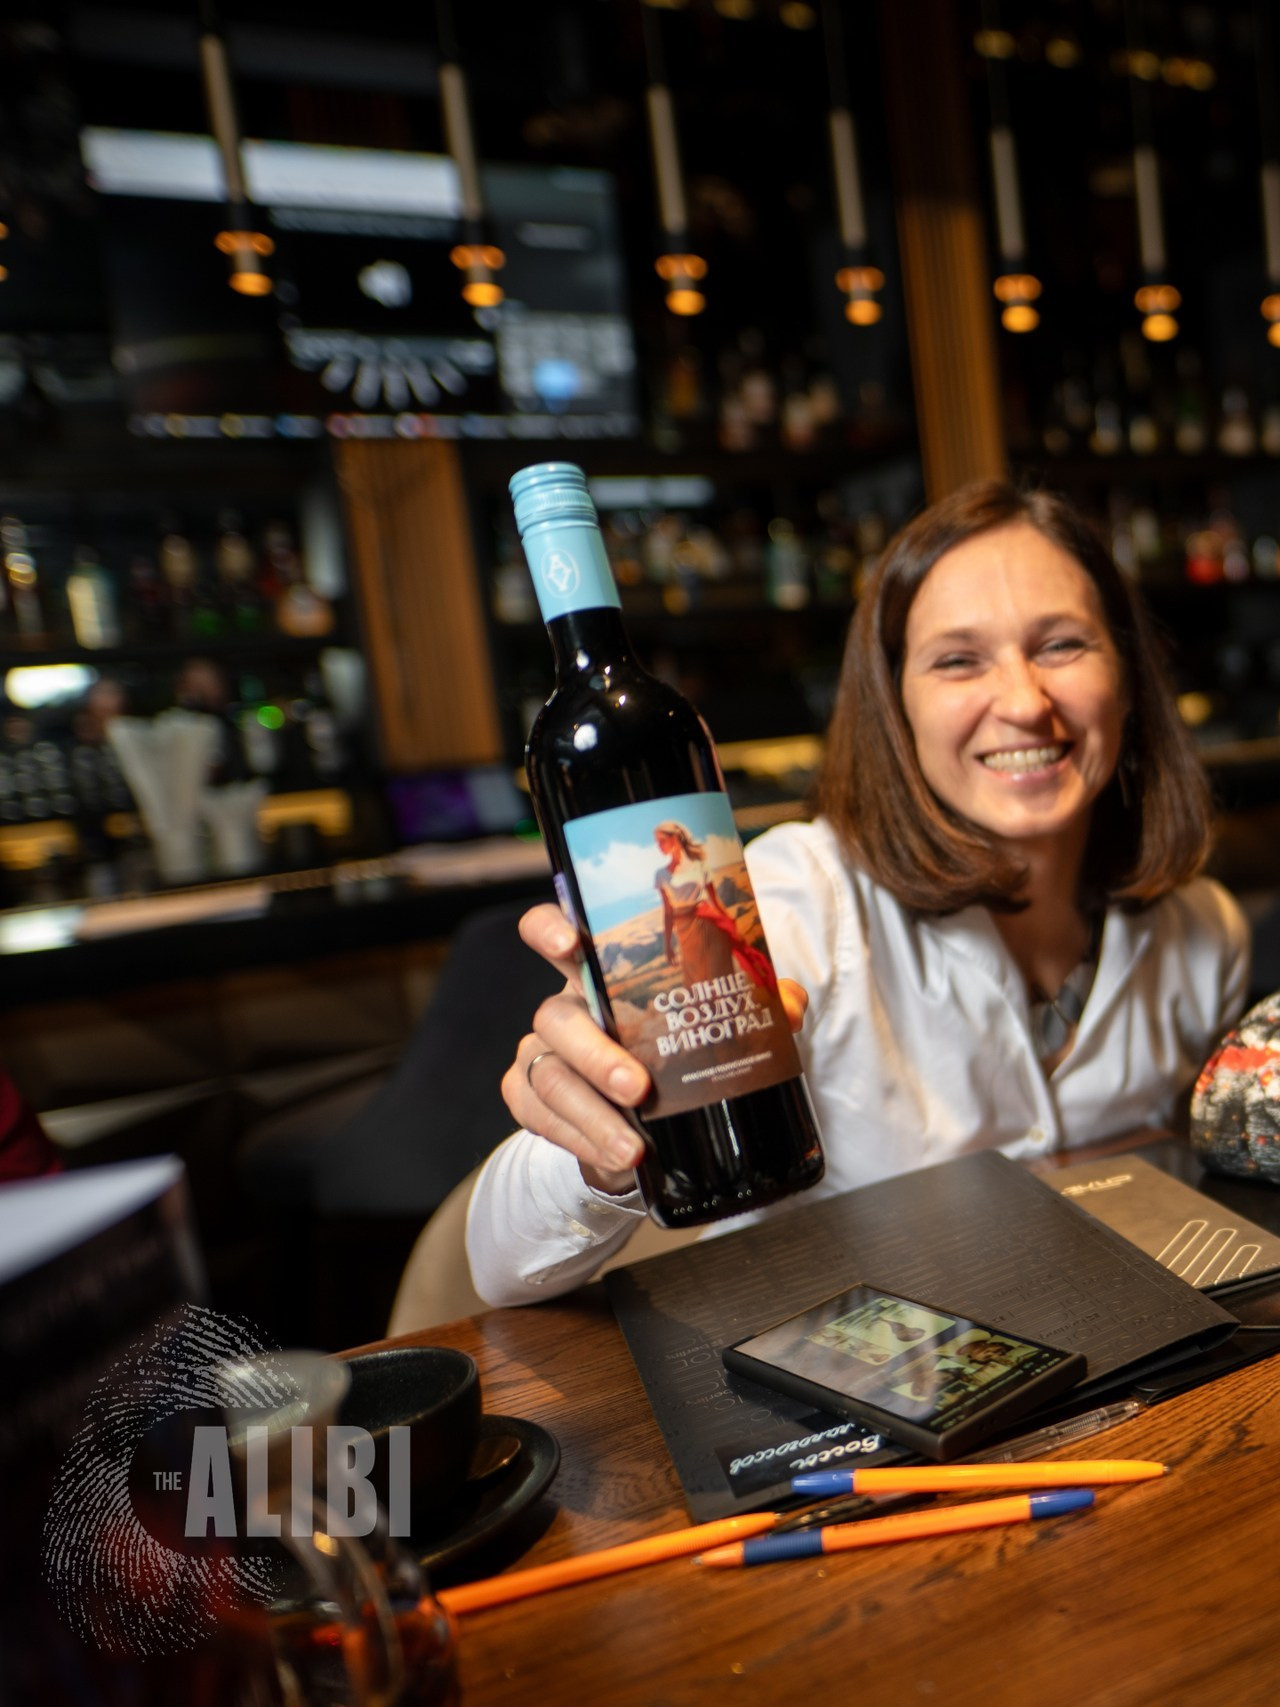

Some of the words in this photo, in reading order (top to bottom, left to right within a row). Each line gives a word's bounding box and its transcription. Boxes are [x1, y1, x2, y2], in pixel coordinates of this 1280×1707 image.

[653, 971, 756, 1012] СОЛНЦЕ.
[665, 990, 761, 1032] ВОЗДУХ.
[655, 1007, 774, 1057] ВИНОГРАД
[789, 1433, 881, 1469] Боссы
